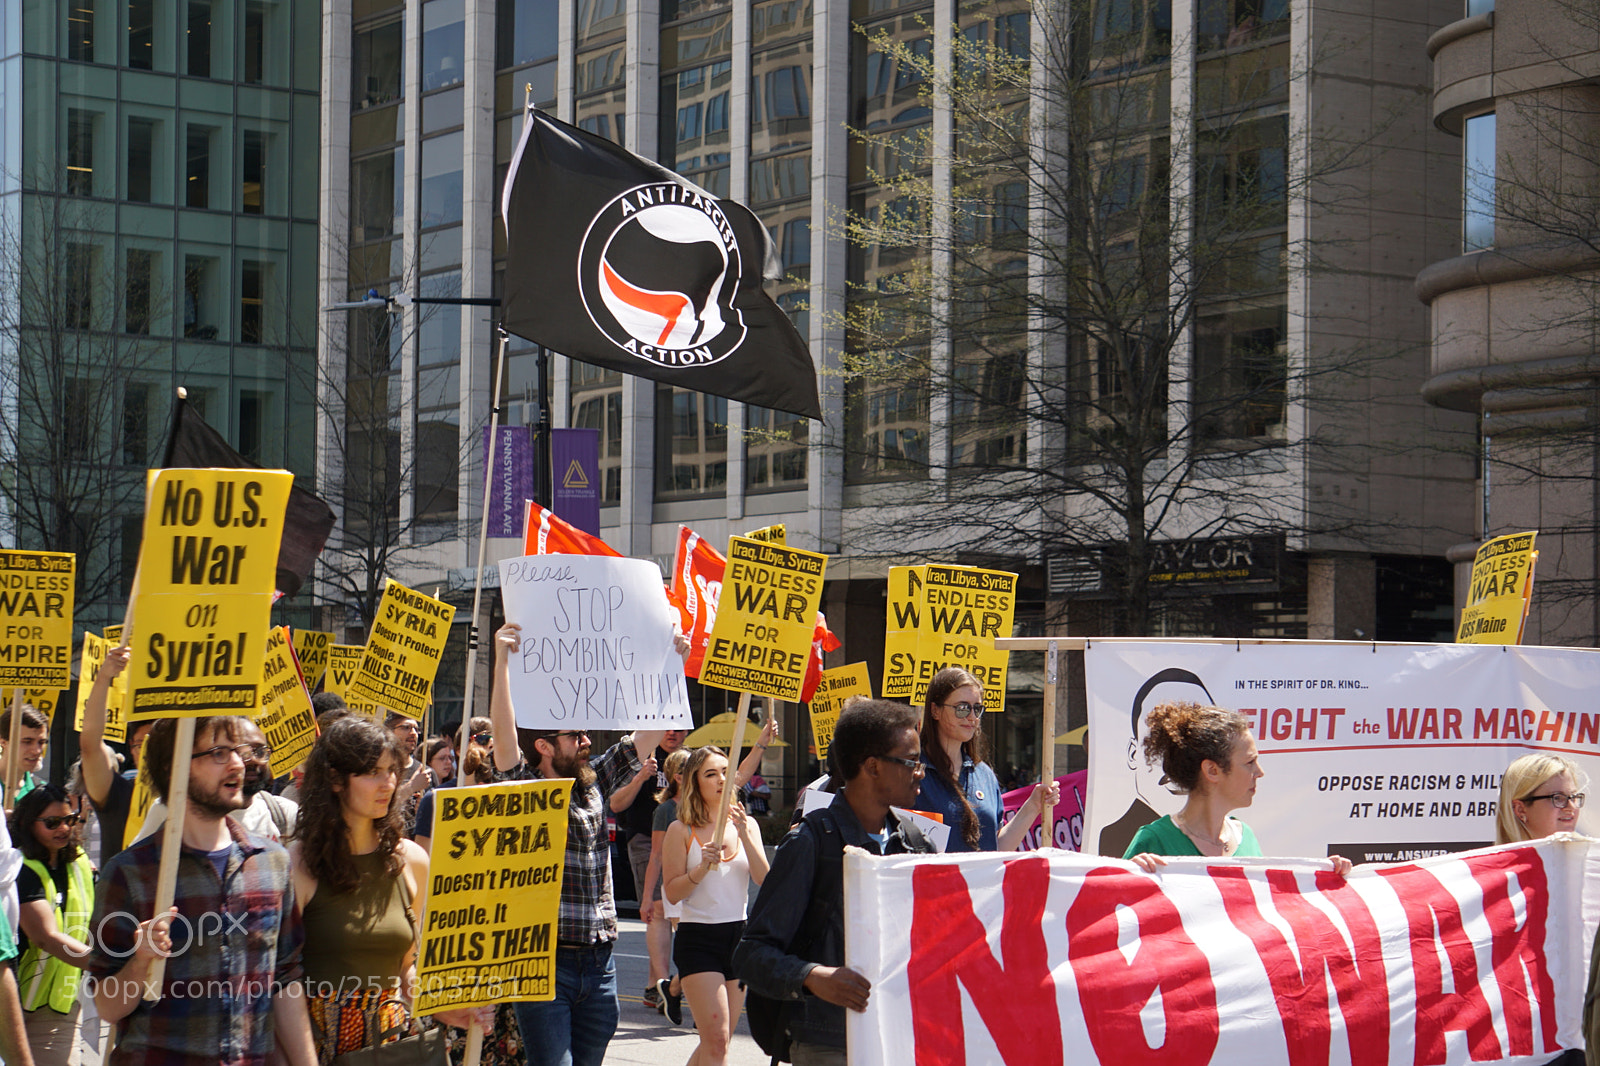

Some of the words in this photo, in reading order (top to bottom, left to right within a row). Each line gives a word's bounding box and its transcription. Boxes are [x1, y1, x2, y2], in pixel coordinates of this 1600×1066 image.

[620, 186, 738, 253] ANTIFASCIST
[623, 338, 713, 365] ACTION
[503, 429, 512, 512] PENNSYLVANIA
[160, 480, 204, 527] No
[212, 481, 267, 528] U.S.
[503, 513, 512, 535] AVE
[9, 553, 39, 570] Libya,
[41, 555, 71, 572] Syria:
[170, 535, 247, 585] War
[733, 540, 757, 560] Iraq,
[759, 546, 786, 568] Libya,
[787, 552, 821, 573] Syria:
[1148, 539, 1253, 571] AYLOR
[1474, 554, 1526, 581] ENDLESS
[0, 574, 69, 591] NDLESS
[504, 562, 578, 586] Please,
[731, 563, 817, 595] ENDLESS
[927, 568, 949, 585] Iraq,
[950, 570, 979, 588] Libya,
[981, 574, 1011, 590] Syria:
[1472, 571, 1518, 605] WAR
[0, 590, 64, 618] WAR
[386, 584, 450, 622] BOMBING
[554, 586, 624, 633] STOP
[735, 583, 807, 623] WAR
[926, 588, 1009, 611] ENDLESS
[185, 604, 218, 628] on
[386, 604, 437, 639] SYRIA
[930, 606, 1003, 638] WAR
[1460, 620, 1475, 640] USS
[1475, 616, 1507, 634] Maine
[6, 625, 43, 640] FOR
[303, 632, 327, 649] NO
[374, 622, 404, 647] Doesn't
[403, 636, 440, 660] Protect
[744, 623, 779, 643] FOR
[0, 644, 67, 664] MPIRE
[146, 632, 248, 681] Syria!
[370, 640, 396, 663] People.
[397, 653, 407, 667] It
[523, 636, 634, 674] BOMBING
[712, 638, 804, 674] EMPIRE
[942, 643, 978, 659] FOR
[263, 653, 288, 683] RIA
[362, 654, 391, 680] KILLS
[393, 668, 431, 696] THEM
[707, 663, 748, 680] ANSWER
[749, 670, 800, 689] COALITION
[829, 676, 857, 691] Maine
[1235, 680, 1245, 689] IN
[1246, 679, 1267, 689] THE
[1270, 679, 1303, 689] SPIRIT
[1305, 679, 1318, 689] OF
[1320, 679, 1336, 689] DR.
[1338, 679, 1369, 689] KING...
[286, 709, 315, 733] THEM
[812, 700, 832, 714] Gulf
[1353, 718, 1380, 735] the
[1386, 707, 1463, 740] WAR
[1473, 707, 1600, 744] MACHIN
[1318, 775, 1384, 791] OPPOSE
[1388, 775, 1451, 790] RACISM
[1455, 775, 1466, 789] &
[441, 788, 565, 822] BOMBING
[1349, 803, 1373, 818] AT
[1377, 802, 1424, 818] HOME
[1429, 801, 1461, 817] AND
[448, 822, 551, 860] SYRIA
[432, 869, 497, 896] Doesn't
[499, 863, 559, 890] Protect
[427, 904, 490, 932] People.
[494, 902, 508, 924] It
[423, 931, 486, 969] KILLS
[491, 922, 551, 960] THEM
[907, 857, 1218, 1066] NO
[1206, 846, 1562, 1066] WAR
[421, 966, 477, 992] ANSWER
[479, 958, 548, 984] COALITION
